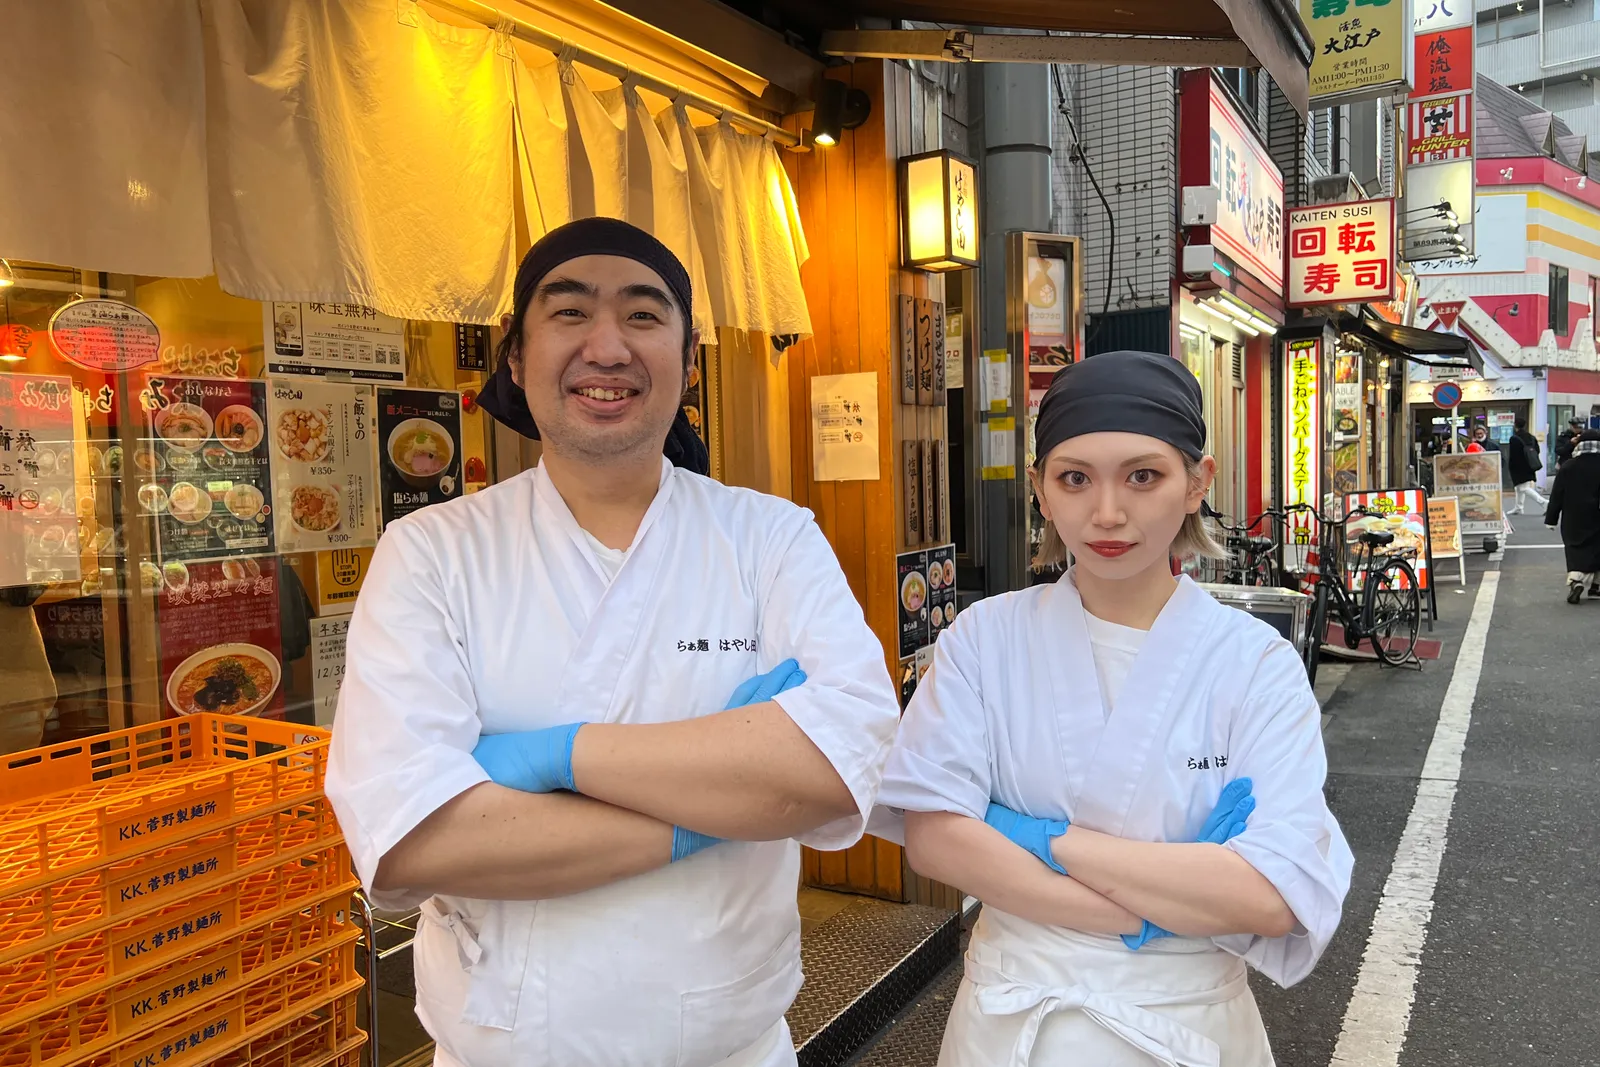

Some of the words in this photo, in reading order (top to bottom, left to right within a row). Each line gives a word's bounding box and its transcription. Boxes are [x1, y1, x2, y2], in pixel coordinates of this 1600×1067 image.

[1323, 28, 1381, 55] 大江戸
[1333, 57, 1368, 72] 営業時間
[1426, 35, 1453, 93] 俺流塩
[1422, 97, 1457, 109] RESTAURANT
[1410, 138, 1471, 154] HUNTER
[1421, 134, 1457, 145] GRILL
[1431, 153, 1447, 162] B1
[1210, 126, 1238, 217] 回転
[1266, 193, 1282, 260] 寿司
[1291, 210, 1337, 224] KAITEN
[1342, 205, 1372, 218] SUSI
[1292, 221, 1376, 259] 回転
[1303, 258, 1388, 294] 寿司
[1437, 305, 1459, 315] 止まれ
[919, 314, 932, 391] つけ麺
[184, 384, 232, 397] おしながき
[393, 491, 429, 505] 塩らぁ麺
[677, 639, 709, 652] らぁ麺
[119, 801, 217, 841] KK.菅野製麺所
[120, 857, 219, 902] KK.菅野製麺所
[124, 911, 223, 959] KK.菅野製麺所
[131, 966, 228, 1019] KK.菅野製麺所
